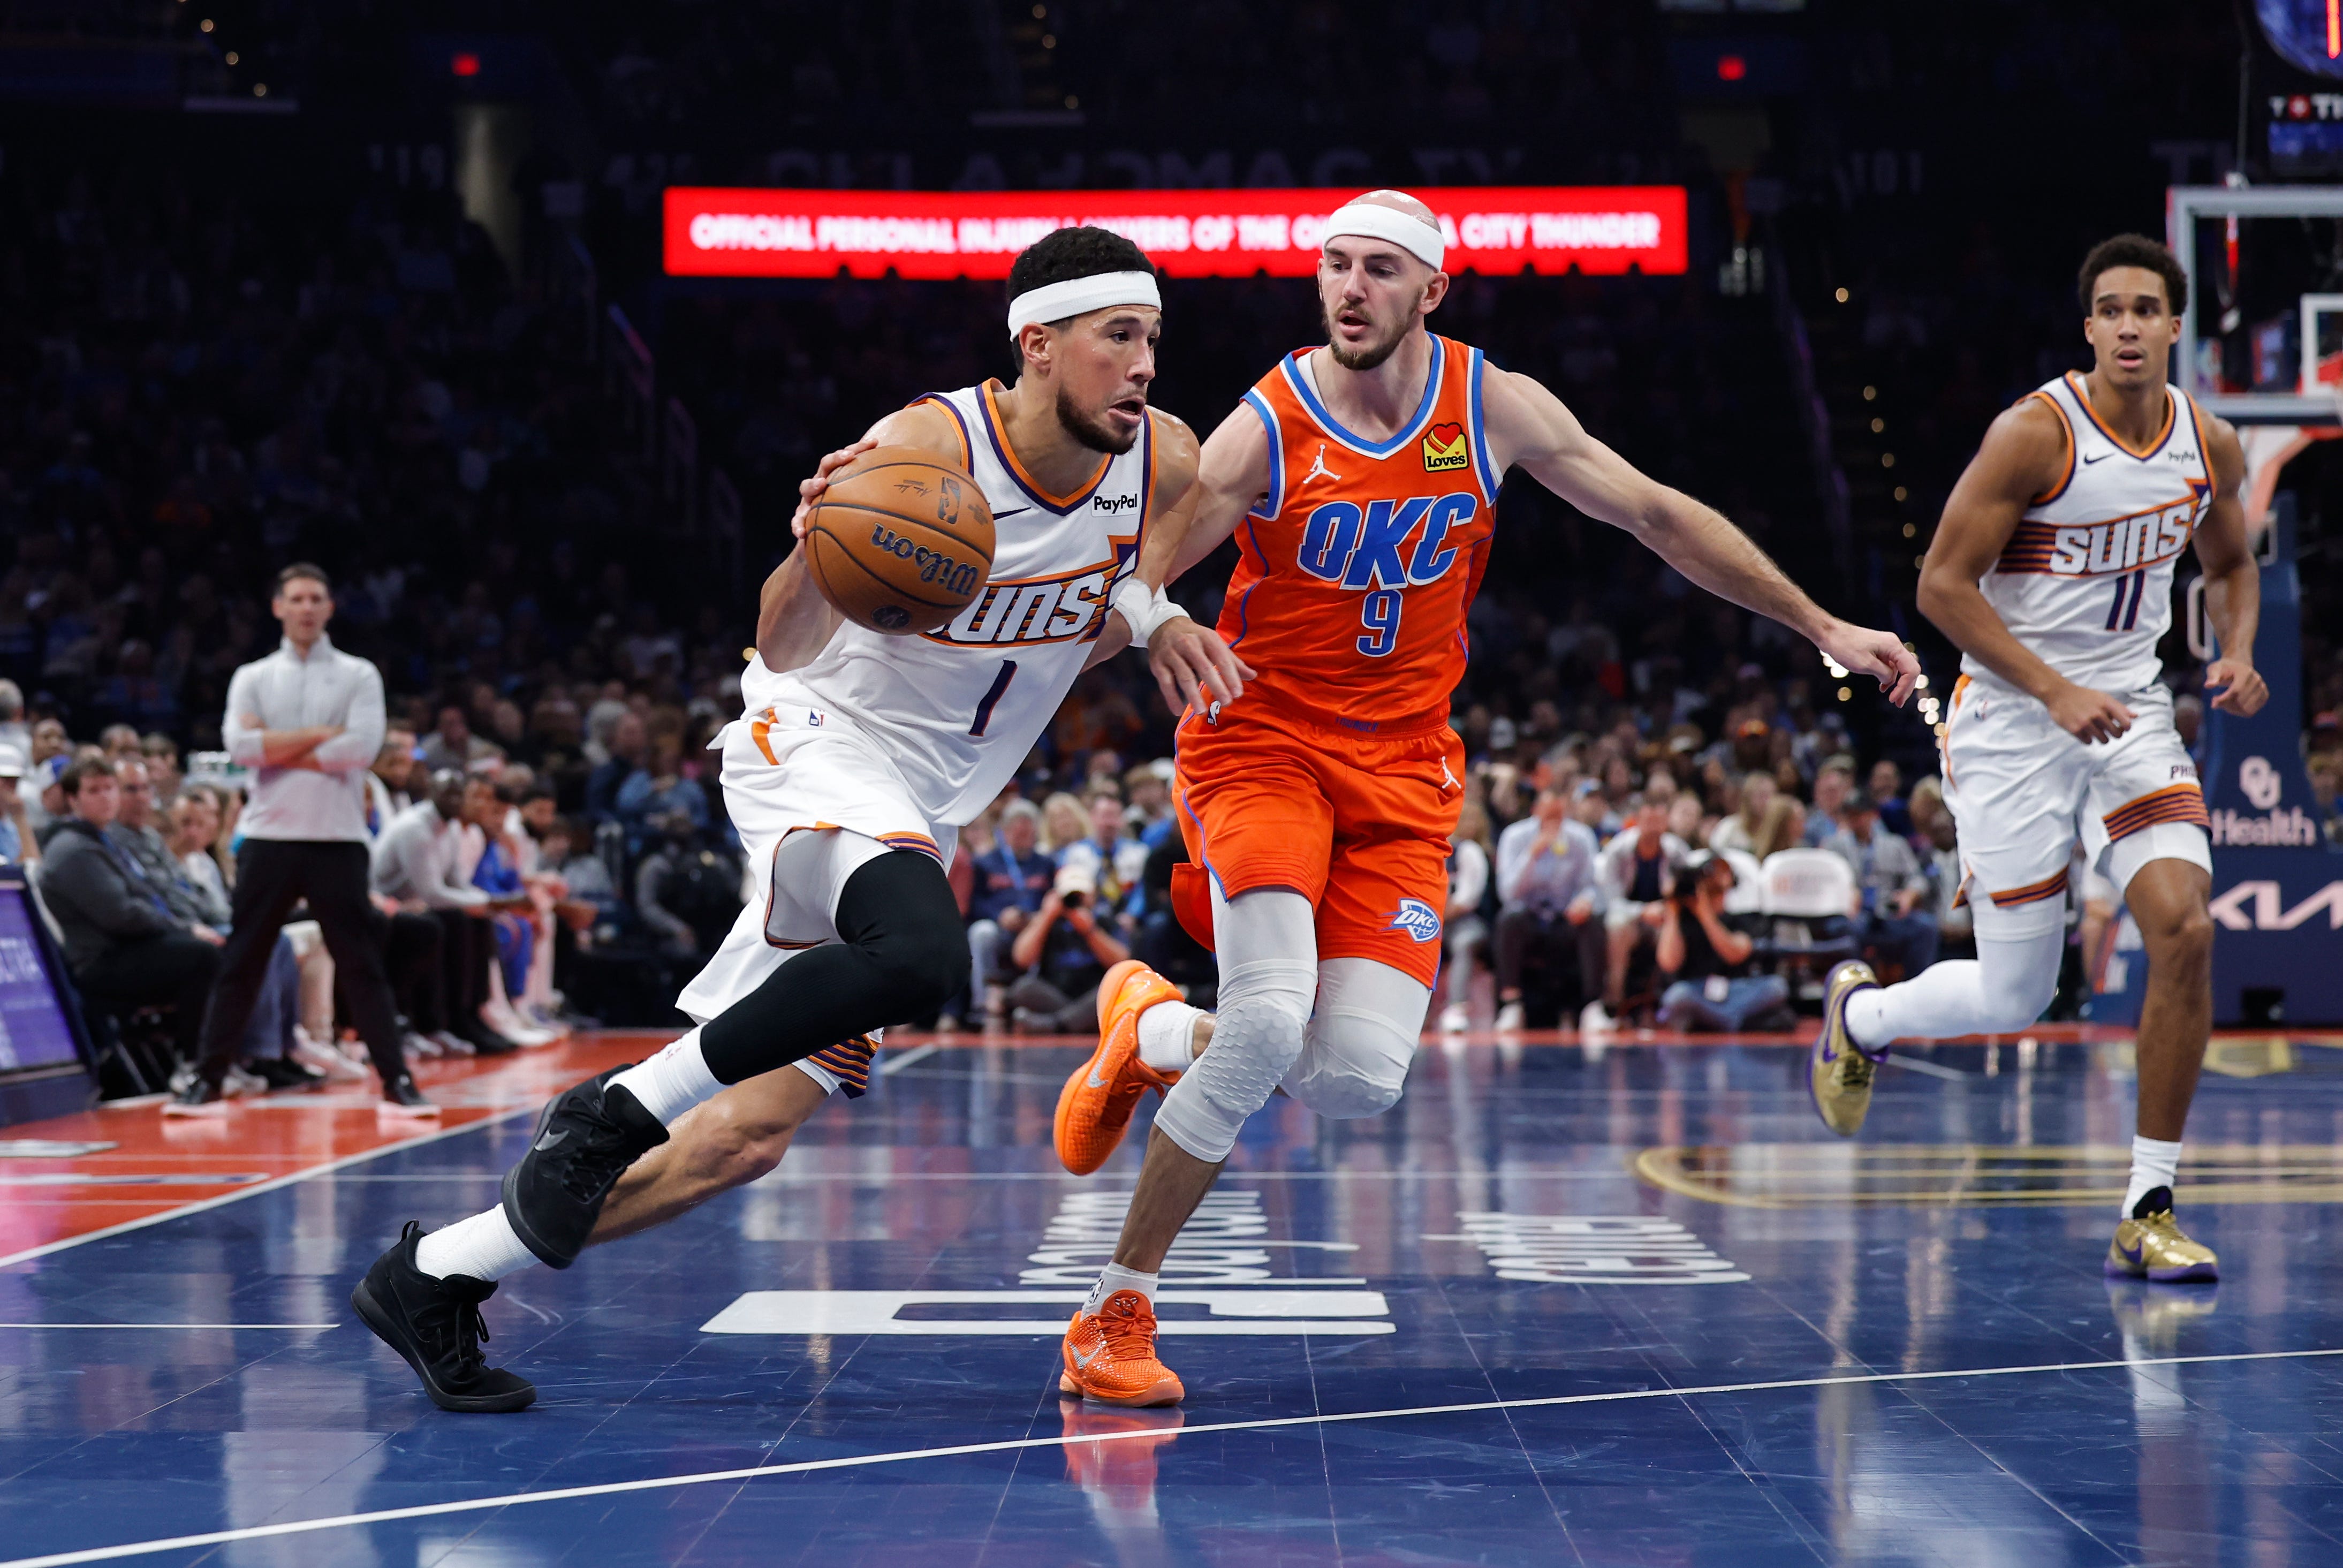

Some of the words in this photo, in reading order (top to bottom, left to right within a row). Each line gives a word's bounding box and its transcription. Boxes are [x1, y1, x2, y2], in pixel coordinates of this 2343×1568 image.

[1192, 215, 1234, 251] OF
[1094, 493, 1138, 514] PayPal
[870, 522, 979, 596] Wilson
[1296, 492, 1477, 590] OKC
[2049, 505, 2192, 574] SUNS
[926, 572, 1106, 642] UNS
[1356, 589, 1403, 657] 9
[2106, 570, 2145, 631] 11
[968, 660, 1018, 737] 1
[2211, 806, 2317, 846] Health
[1393, 910, 1435, 928] OKC
